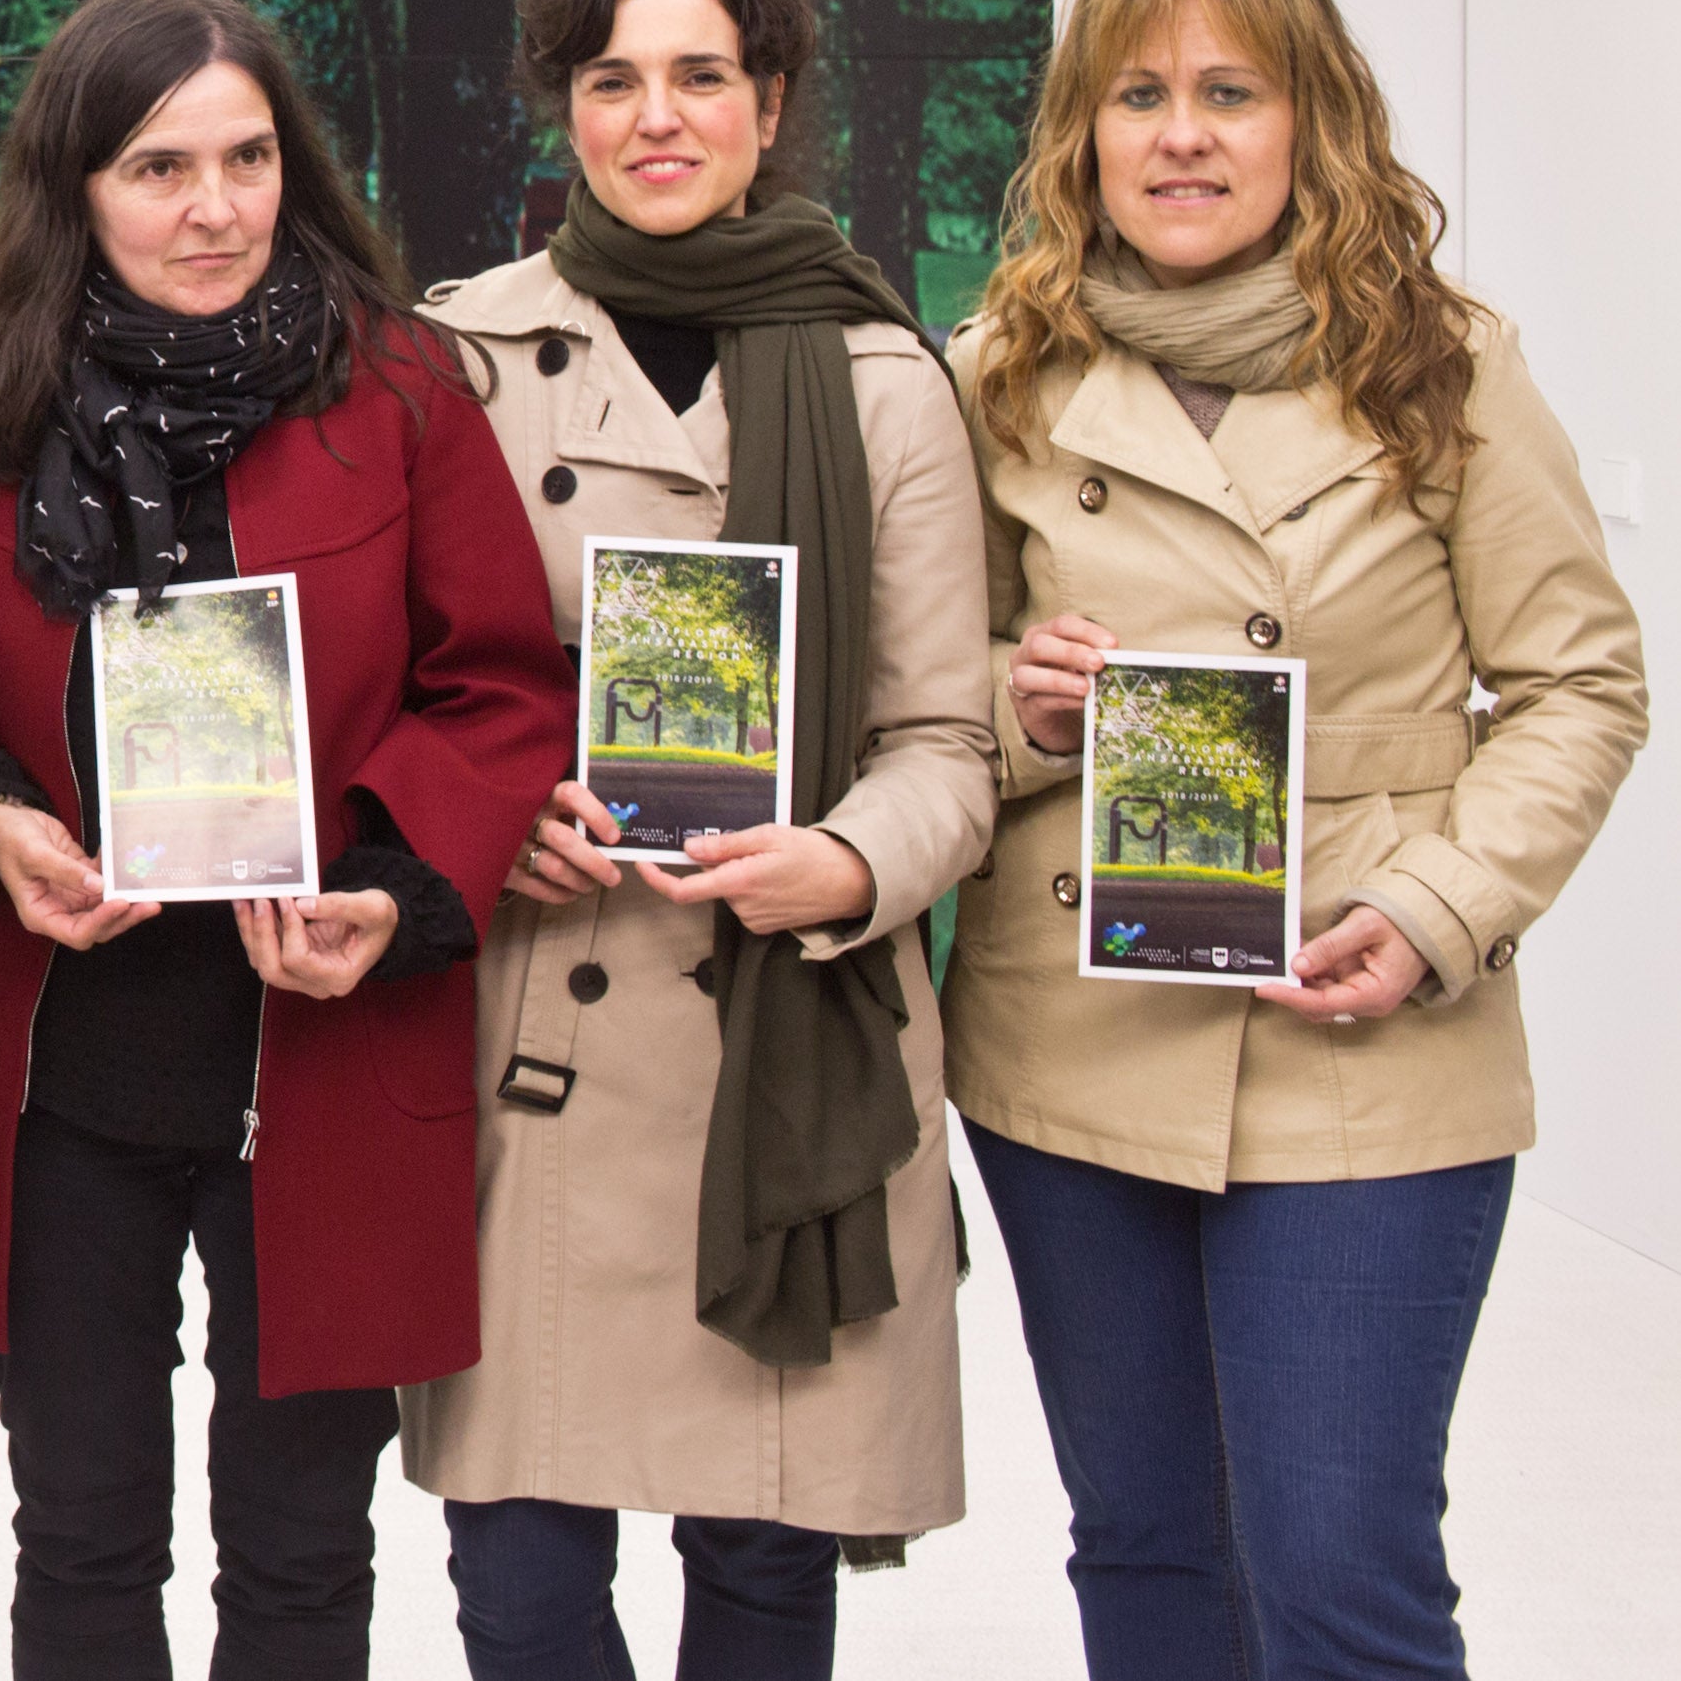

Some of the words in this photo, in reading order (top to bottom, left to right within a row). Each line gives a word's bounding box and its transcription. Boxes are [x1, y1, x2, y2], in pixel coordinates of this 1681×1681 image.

[650, 626, 728, 638] EXPLORE
[673, 649, 741, 661] REGION
[186, 686, 253, 699] REGION
[1155, 743, 1235, 755] EXPLORE
[1123, 753, 1261, 768] SANSEBASTIAN
[1179, 766, 1248, 778] REGION
